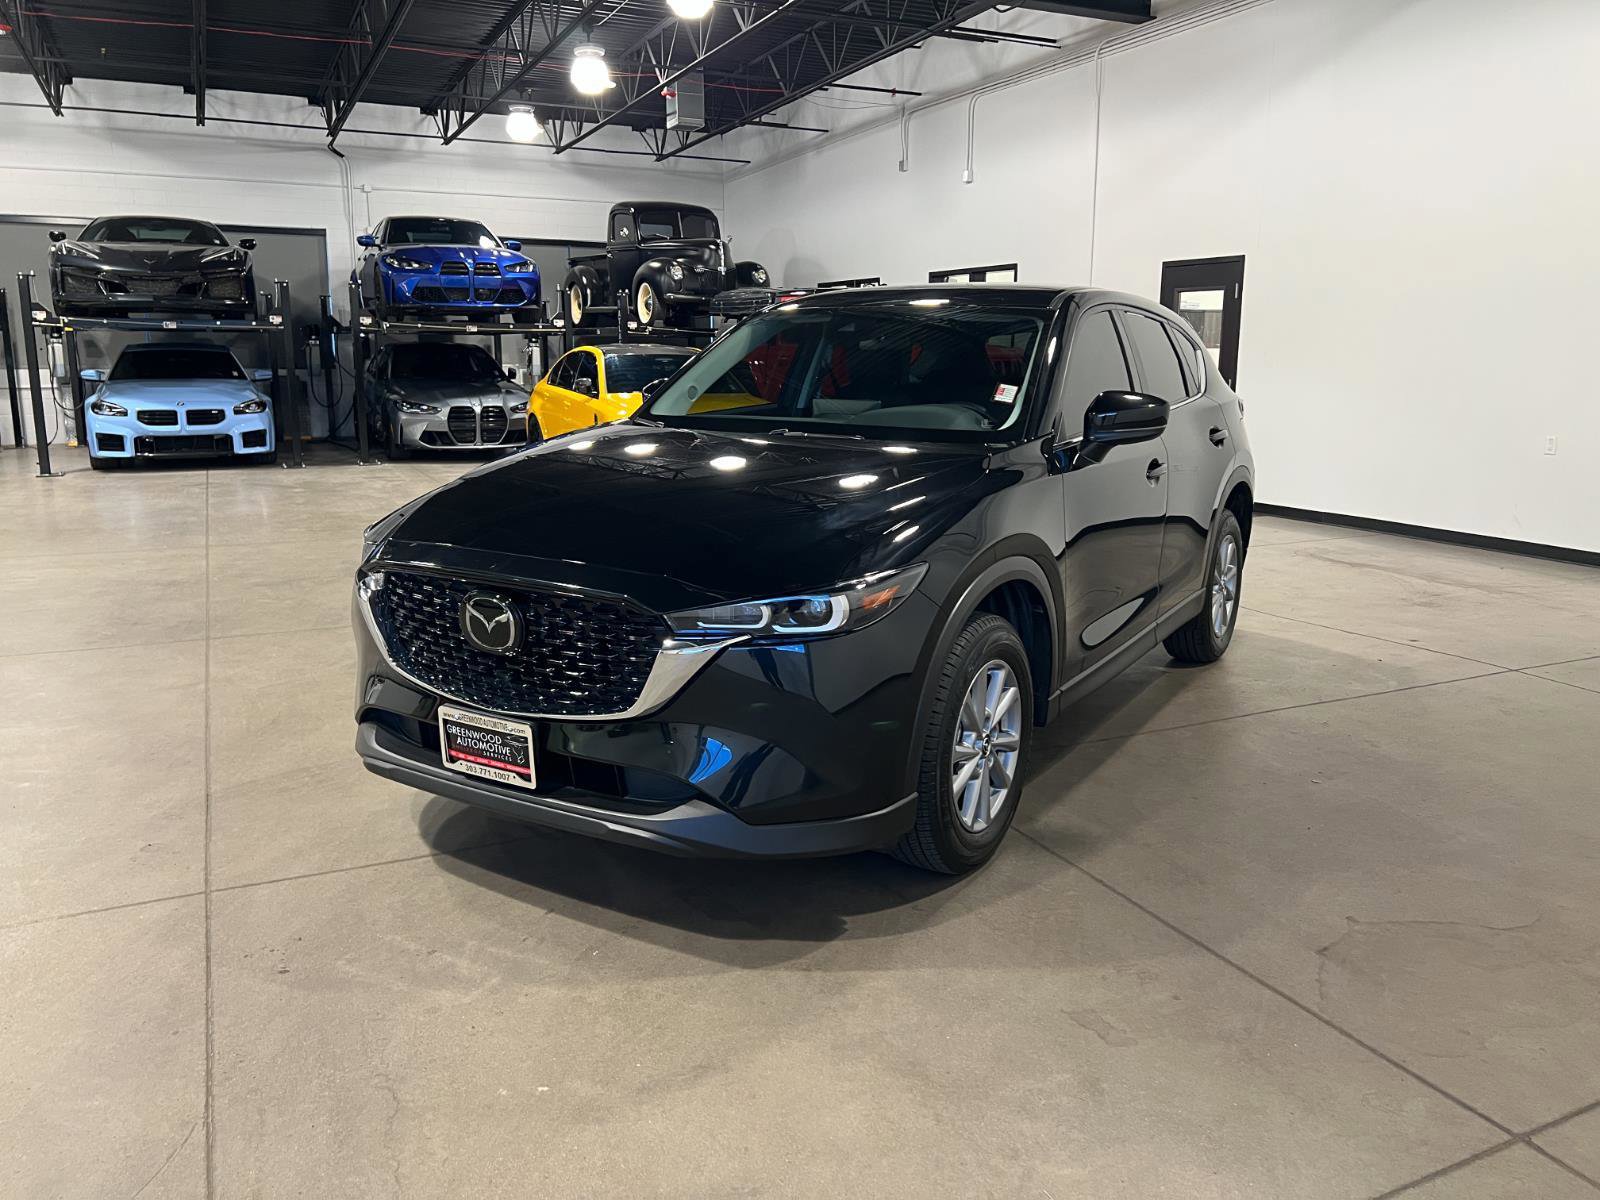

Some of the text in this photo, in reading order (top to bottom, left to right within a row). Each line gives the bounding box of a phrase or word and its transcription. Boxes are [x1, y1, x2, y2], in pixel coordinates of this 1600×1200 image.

[446, 724, 502, 744] GREENWOOD
[456, 737, 511, 756] AUTOMOTIVE
[483, 751, 513, 762] SERVICES
[464, 764, 511, 781] 303.771.1007
